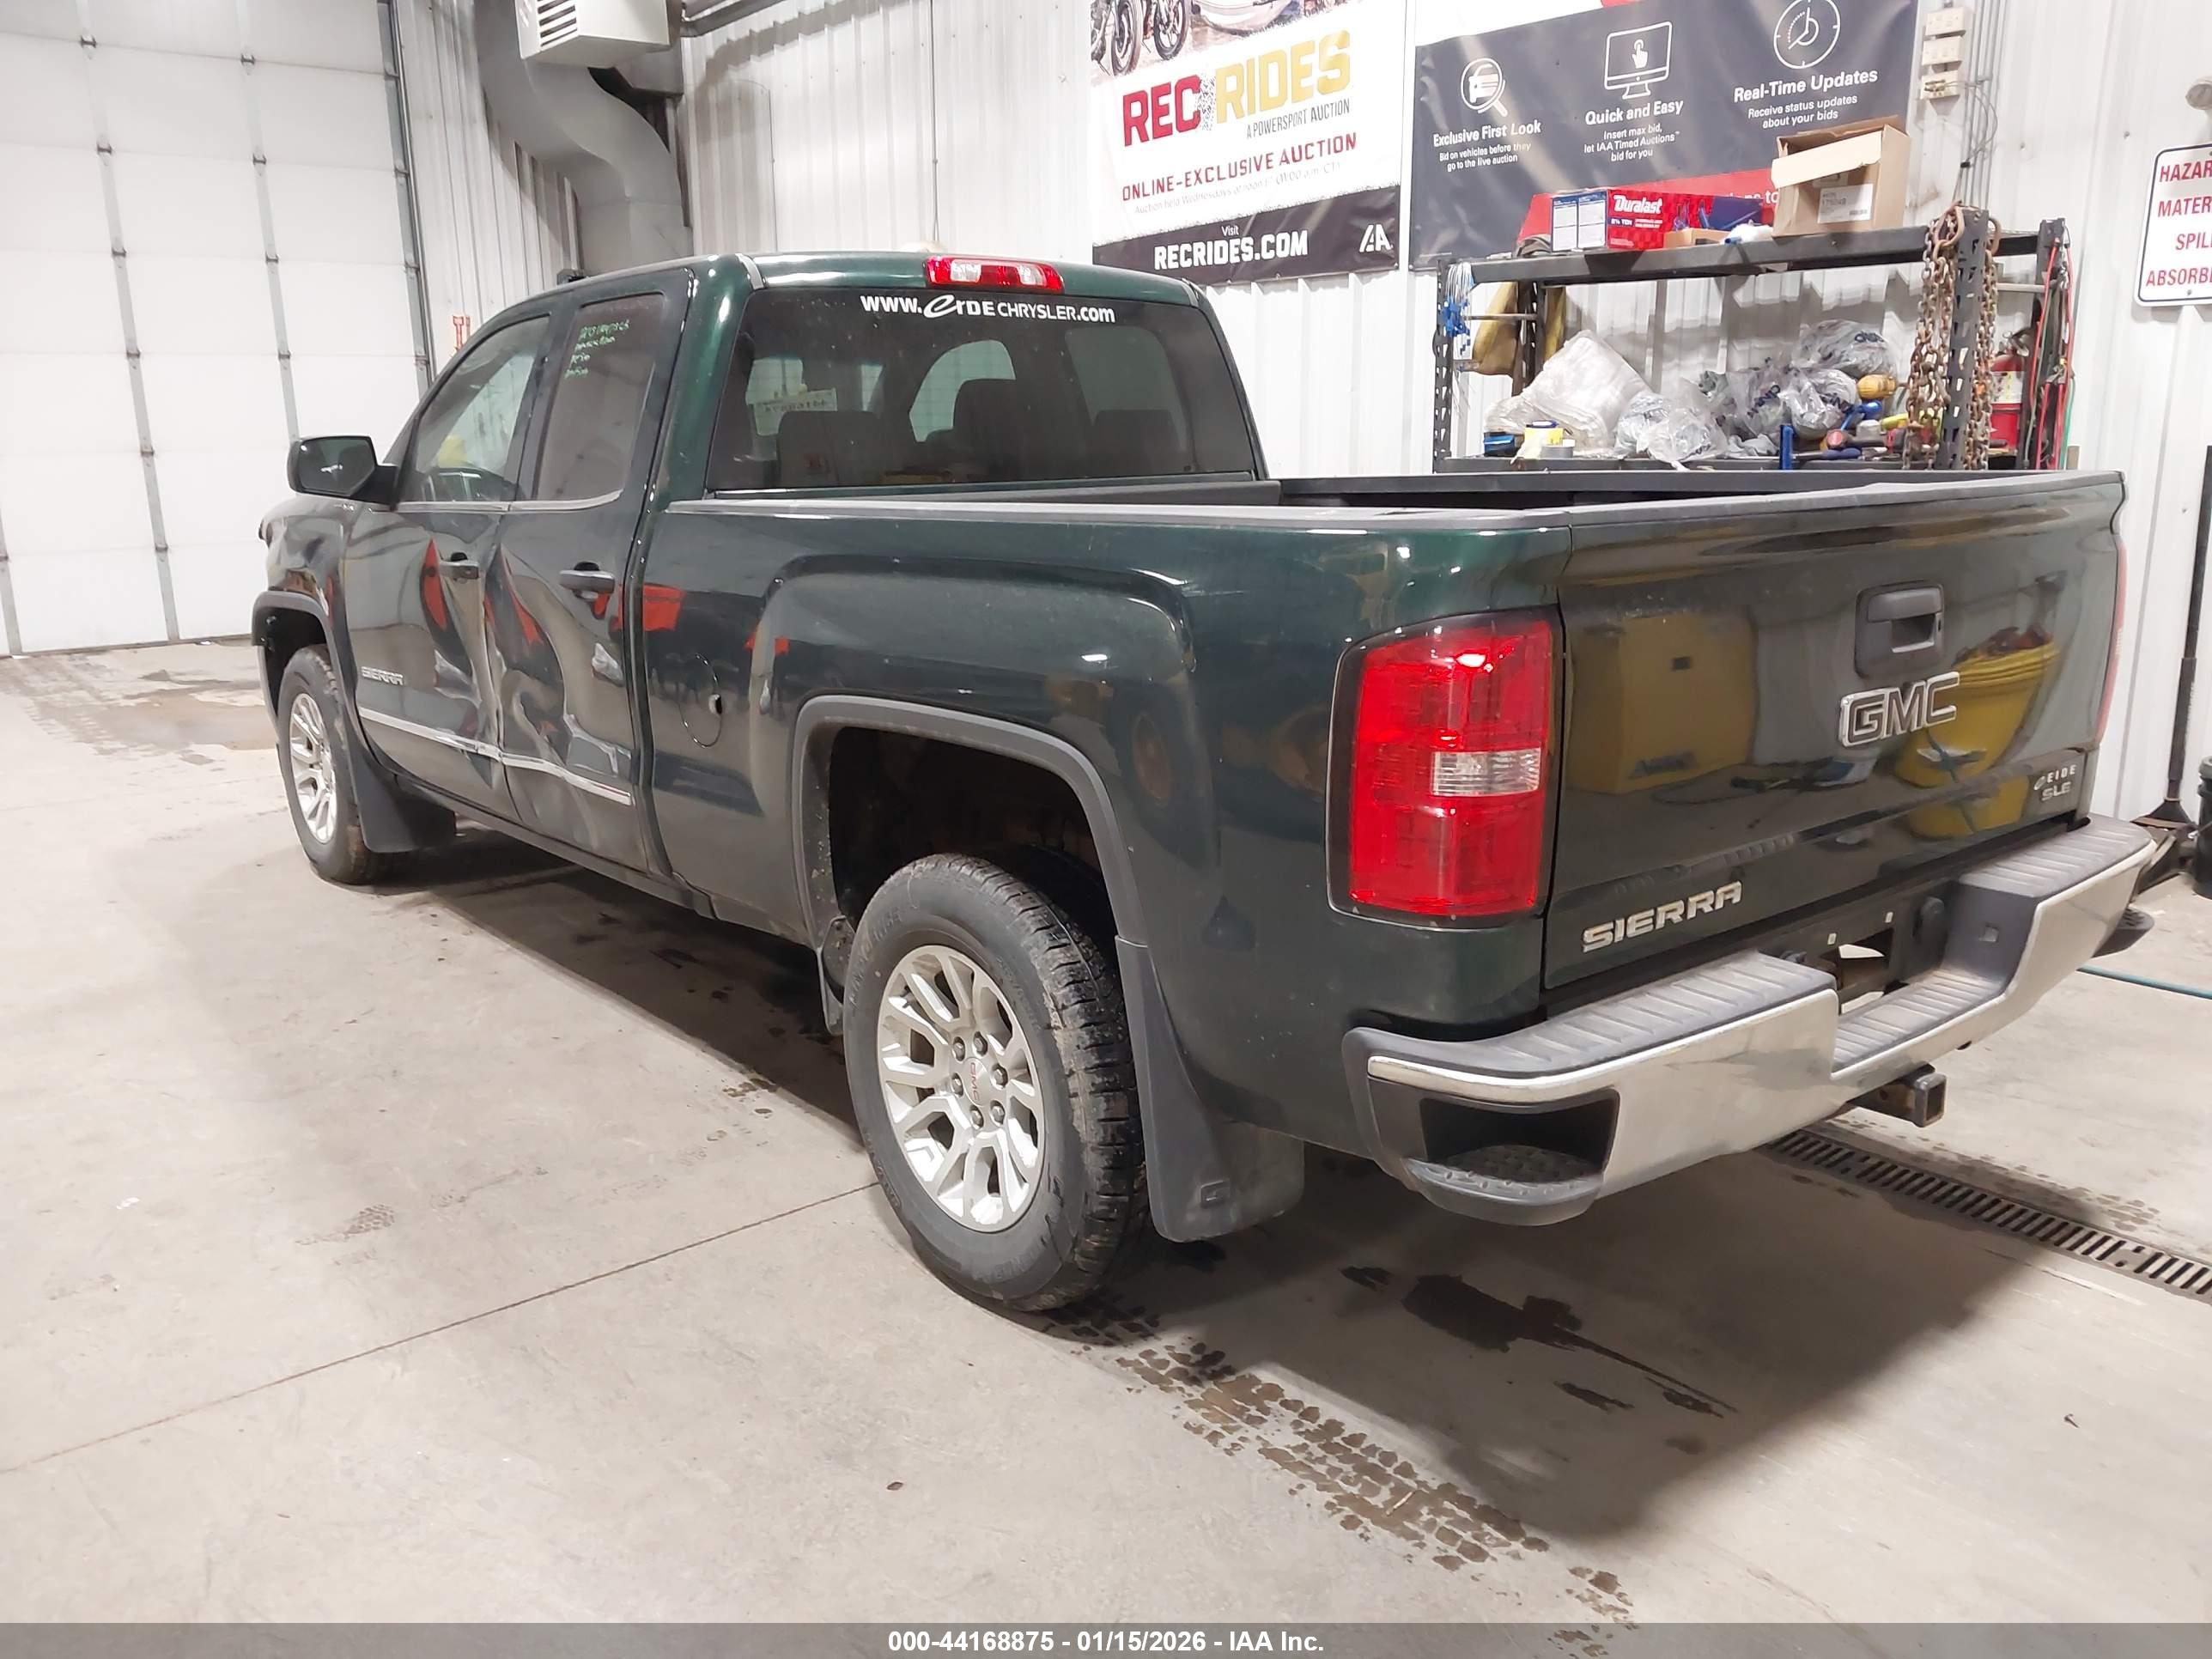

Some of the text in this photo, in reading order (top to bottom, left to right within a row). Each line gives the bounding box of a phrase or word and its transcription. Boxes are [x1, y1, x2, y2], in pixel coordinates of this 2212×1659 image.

[1123, 30, 1351, 146] REC RIDES
[1734, 70, 1878, 102] Real-Time Updates
[1253, 108, 1307, 137] POWERSPORT
[1310, 98, 1350, 122] AUCTION
[1585, 100, 1684, 125] Quick and Easy
[1748, 94, 1858, 118] Receive status updates
[1762, 110, 1838, 129] about your bids
[1433, 119, 1541, 147] Exclusive First Look
[1603, 128, 1626, 140] Insert
[1628, 128, 1645, 137] max
[1614, 138, 1638, 149] Timed
[1439, 142, 1532, 161] Bid on vehicles before they
[1447, 154, 1518, 173] go to the live auction
[1610, 149, 1653, 161] bid for you
[1122, 132, 1357, 201] ONLINE-EXCLUSIVE AUCTION
[1613, 194, 1662, 214] Duralast
[1222, 225, 1239, 236] Visit
[1154, 230, 1308, 270] RECRIDES.COM
[361, 665, 404, 686] SIERRA
[1838, 672, 1960, 746] GMC
[2042, 781, 2071, 801] SLE
[1583, 881, 1741, 952] SIERRA
[970, 1062, 981, 1101] GMC
